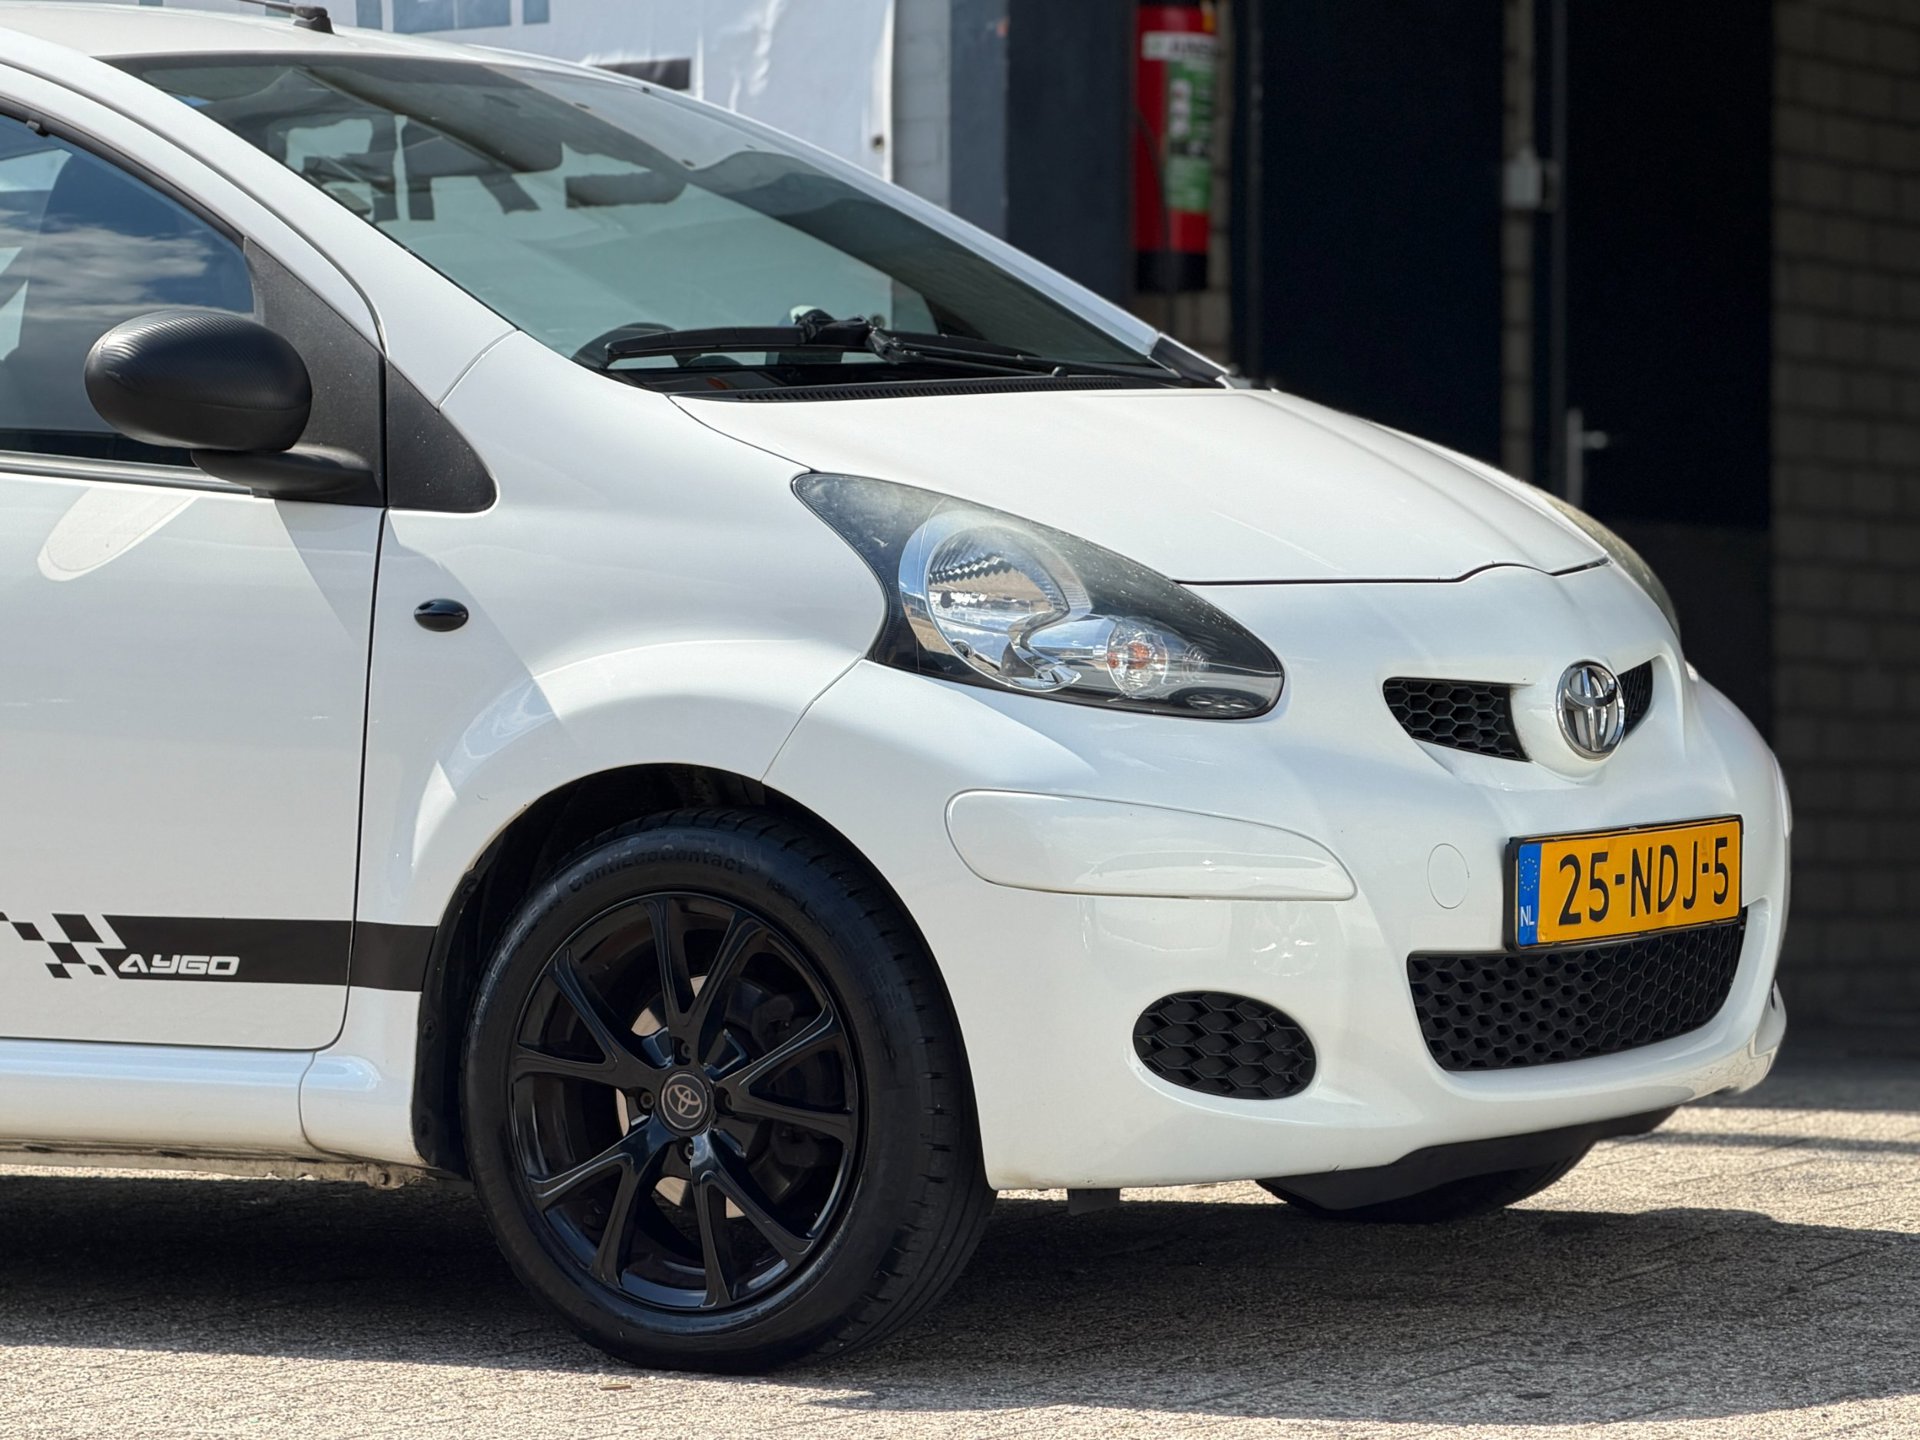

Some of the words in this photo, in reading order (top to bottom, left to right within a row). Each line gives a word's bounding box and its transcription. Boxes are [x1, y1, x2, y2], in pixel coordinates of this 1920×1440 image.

[1558, 837, 1729, 926] 25-NDJ-5
[1520, 906, 1535, 927] NL
[118, 953, 240, 975] AYGO
